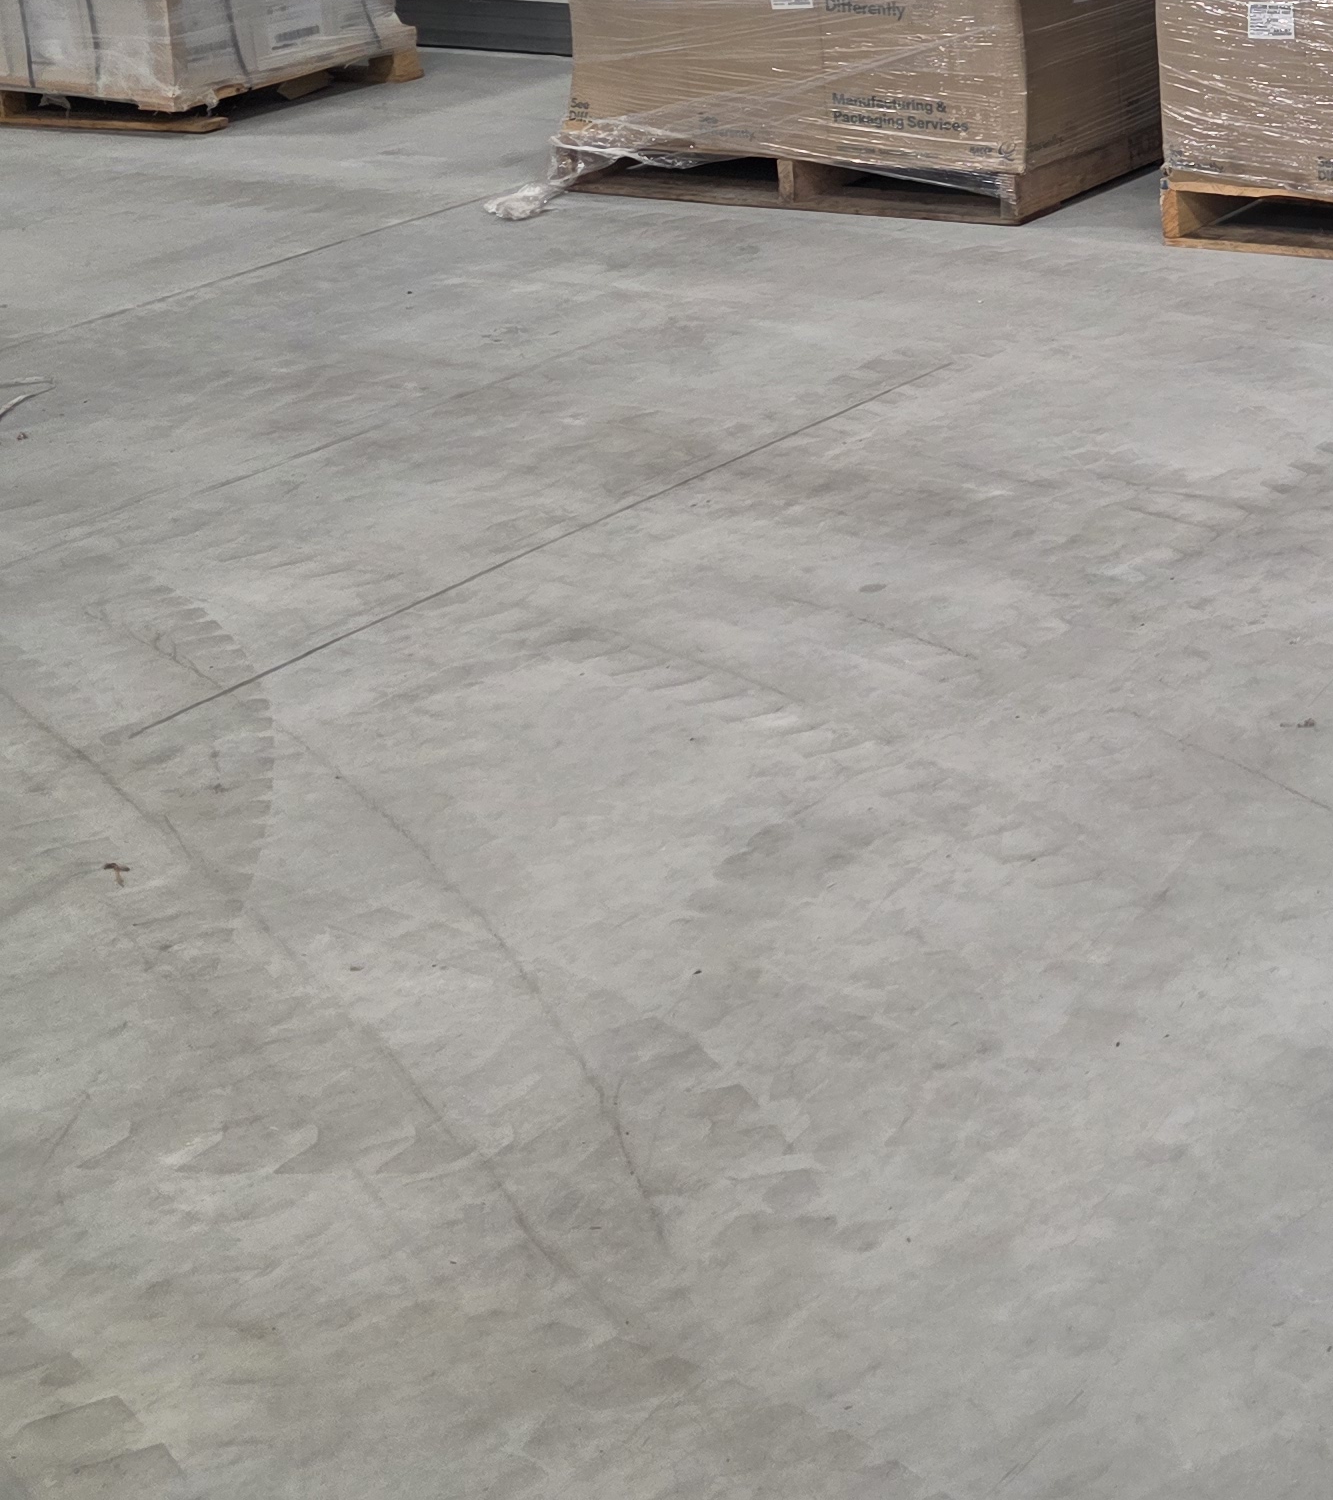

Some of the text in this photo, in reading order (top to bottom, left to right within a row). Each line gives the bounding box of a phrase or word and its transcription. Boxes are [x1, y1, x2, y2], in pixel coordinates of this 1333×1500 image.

[571, 98, 589, 110] See
[832, 93, 947, 115] Manufacturing &
[832, 111, 969, 132] Packaging Services
